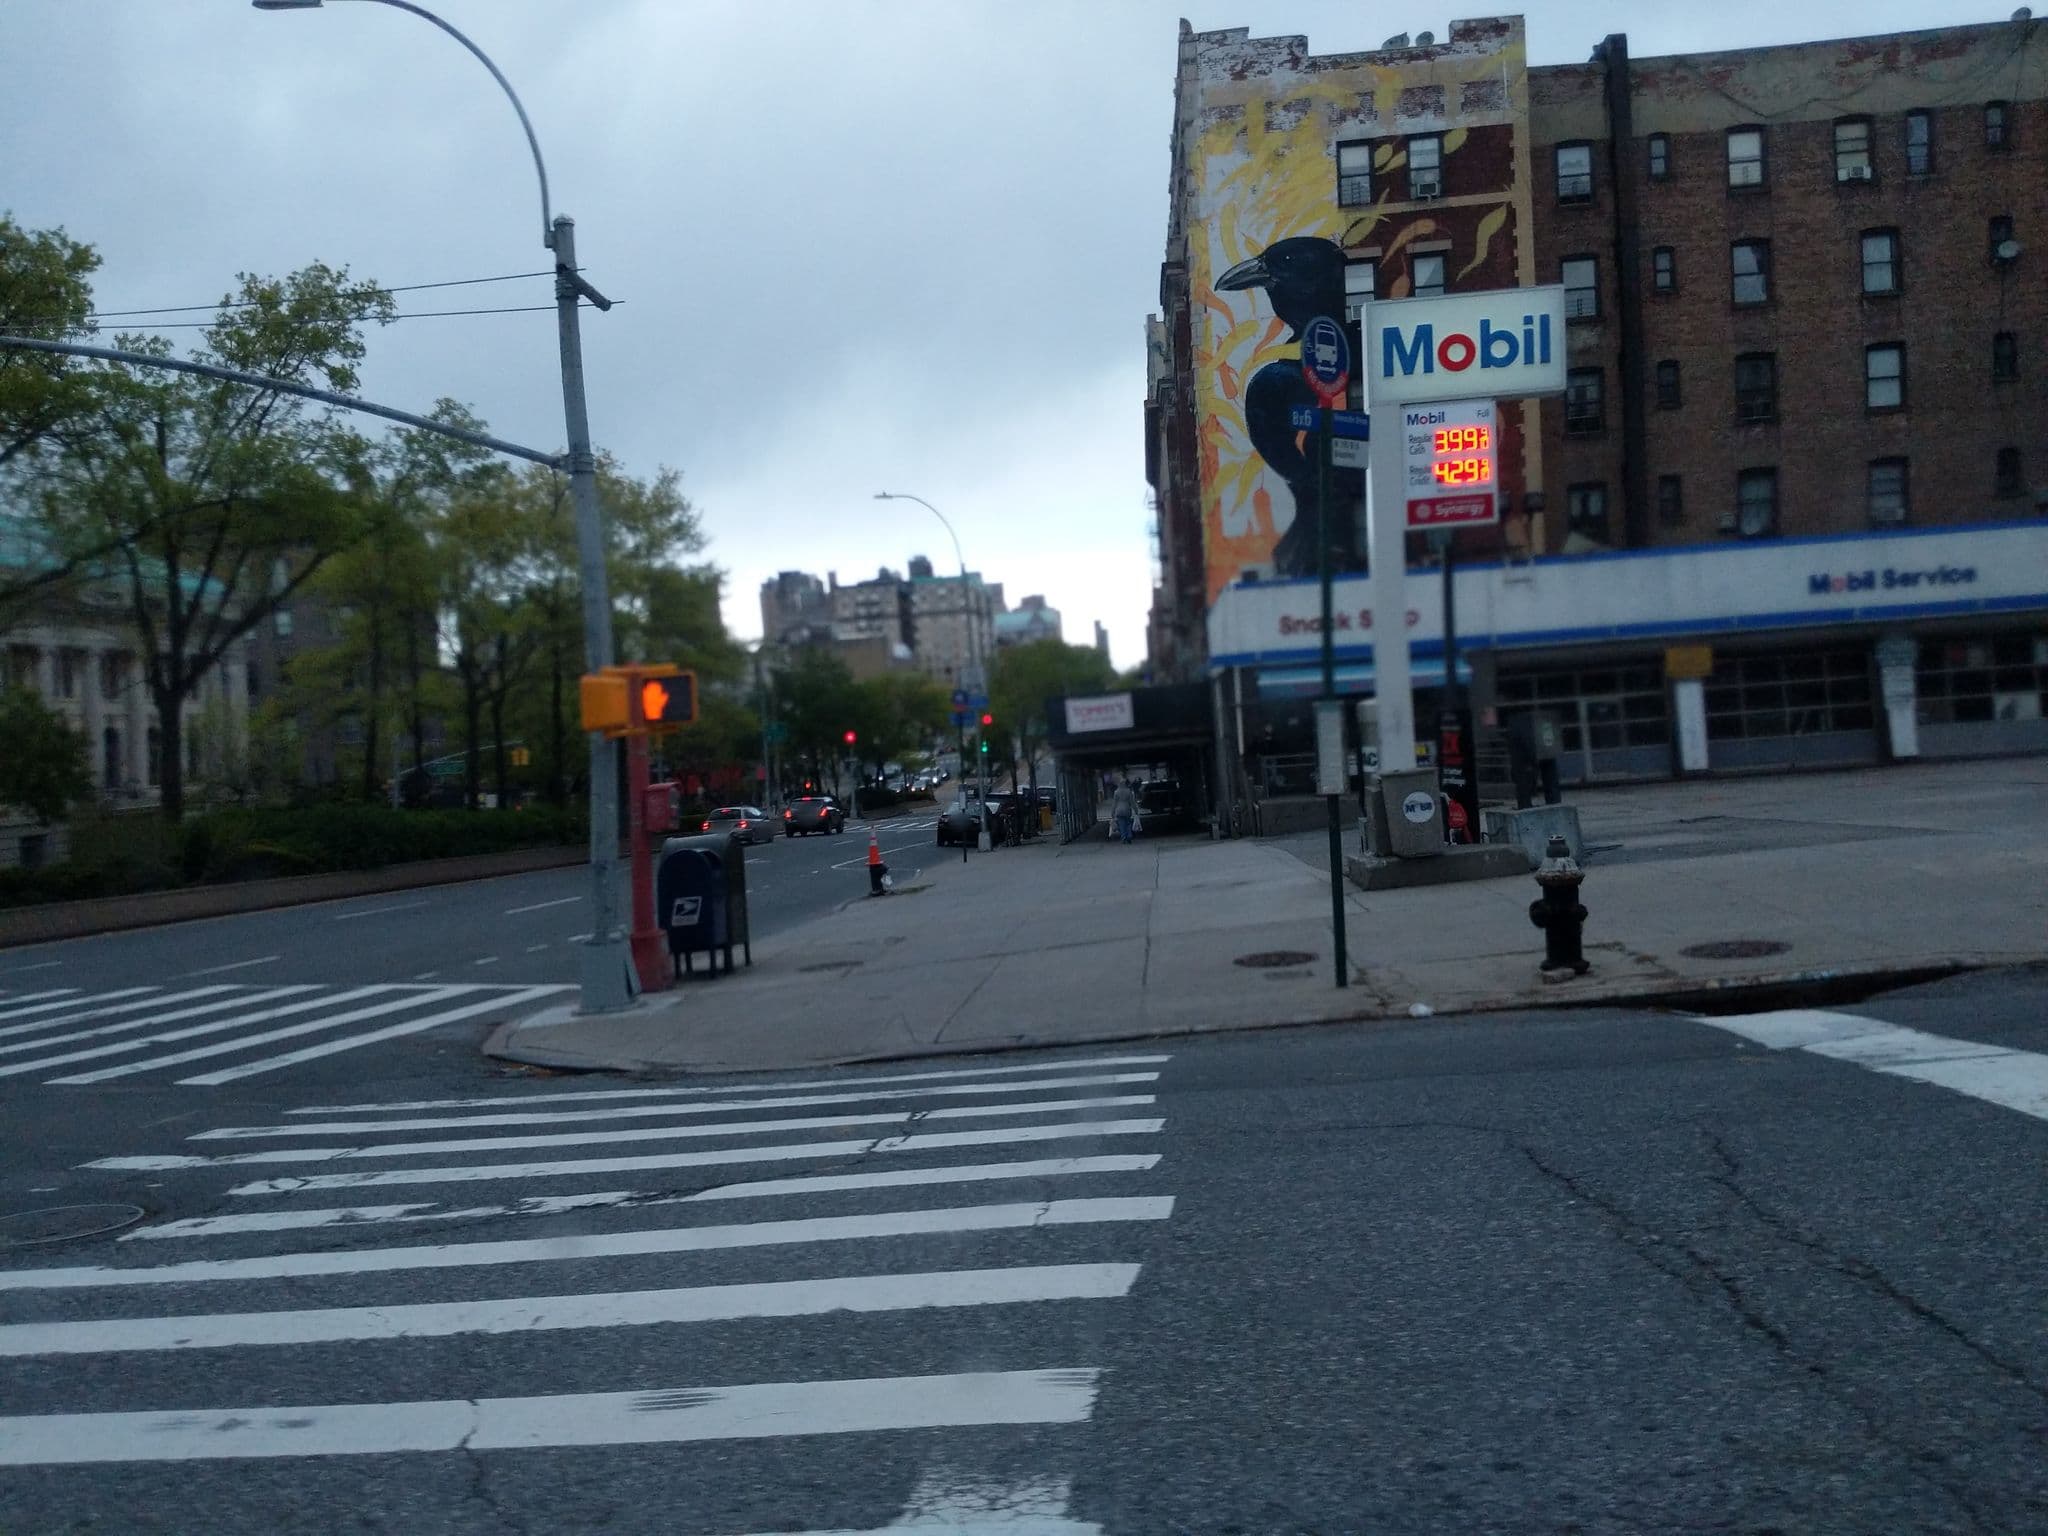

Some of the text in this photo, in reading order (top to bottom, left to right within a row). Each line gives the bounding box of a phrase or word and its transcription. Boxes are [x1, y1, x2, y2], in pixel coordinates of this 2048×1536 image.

[1382, 313, 1551, 377] Mobil
[1406, 411, 1446, 426] Mobil
[1435, 502, 1486, 518] Synergy
[1808, 564, 1976, 594] Mobil Service
[1279, 614, 1350, 636] Snak
